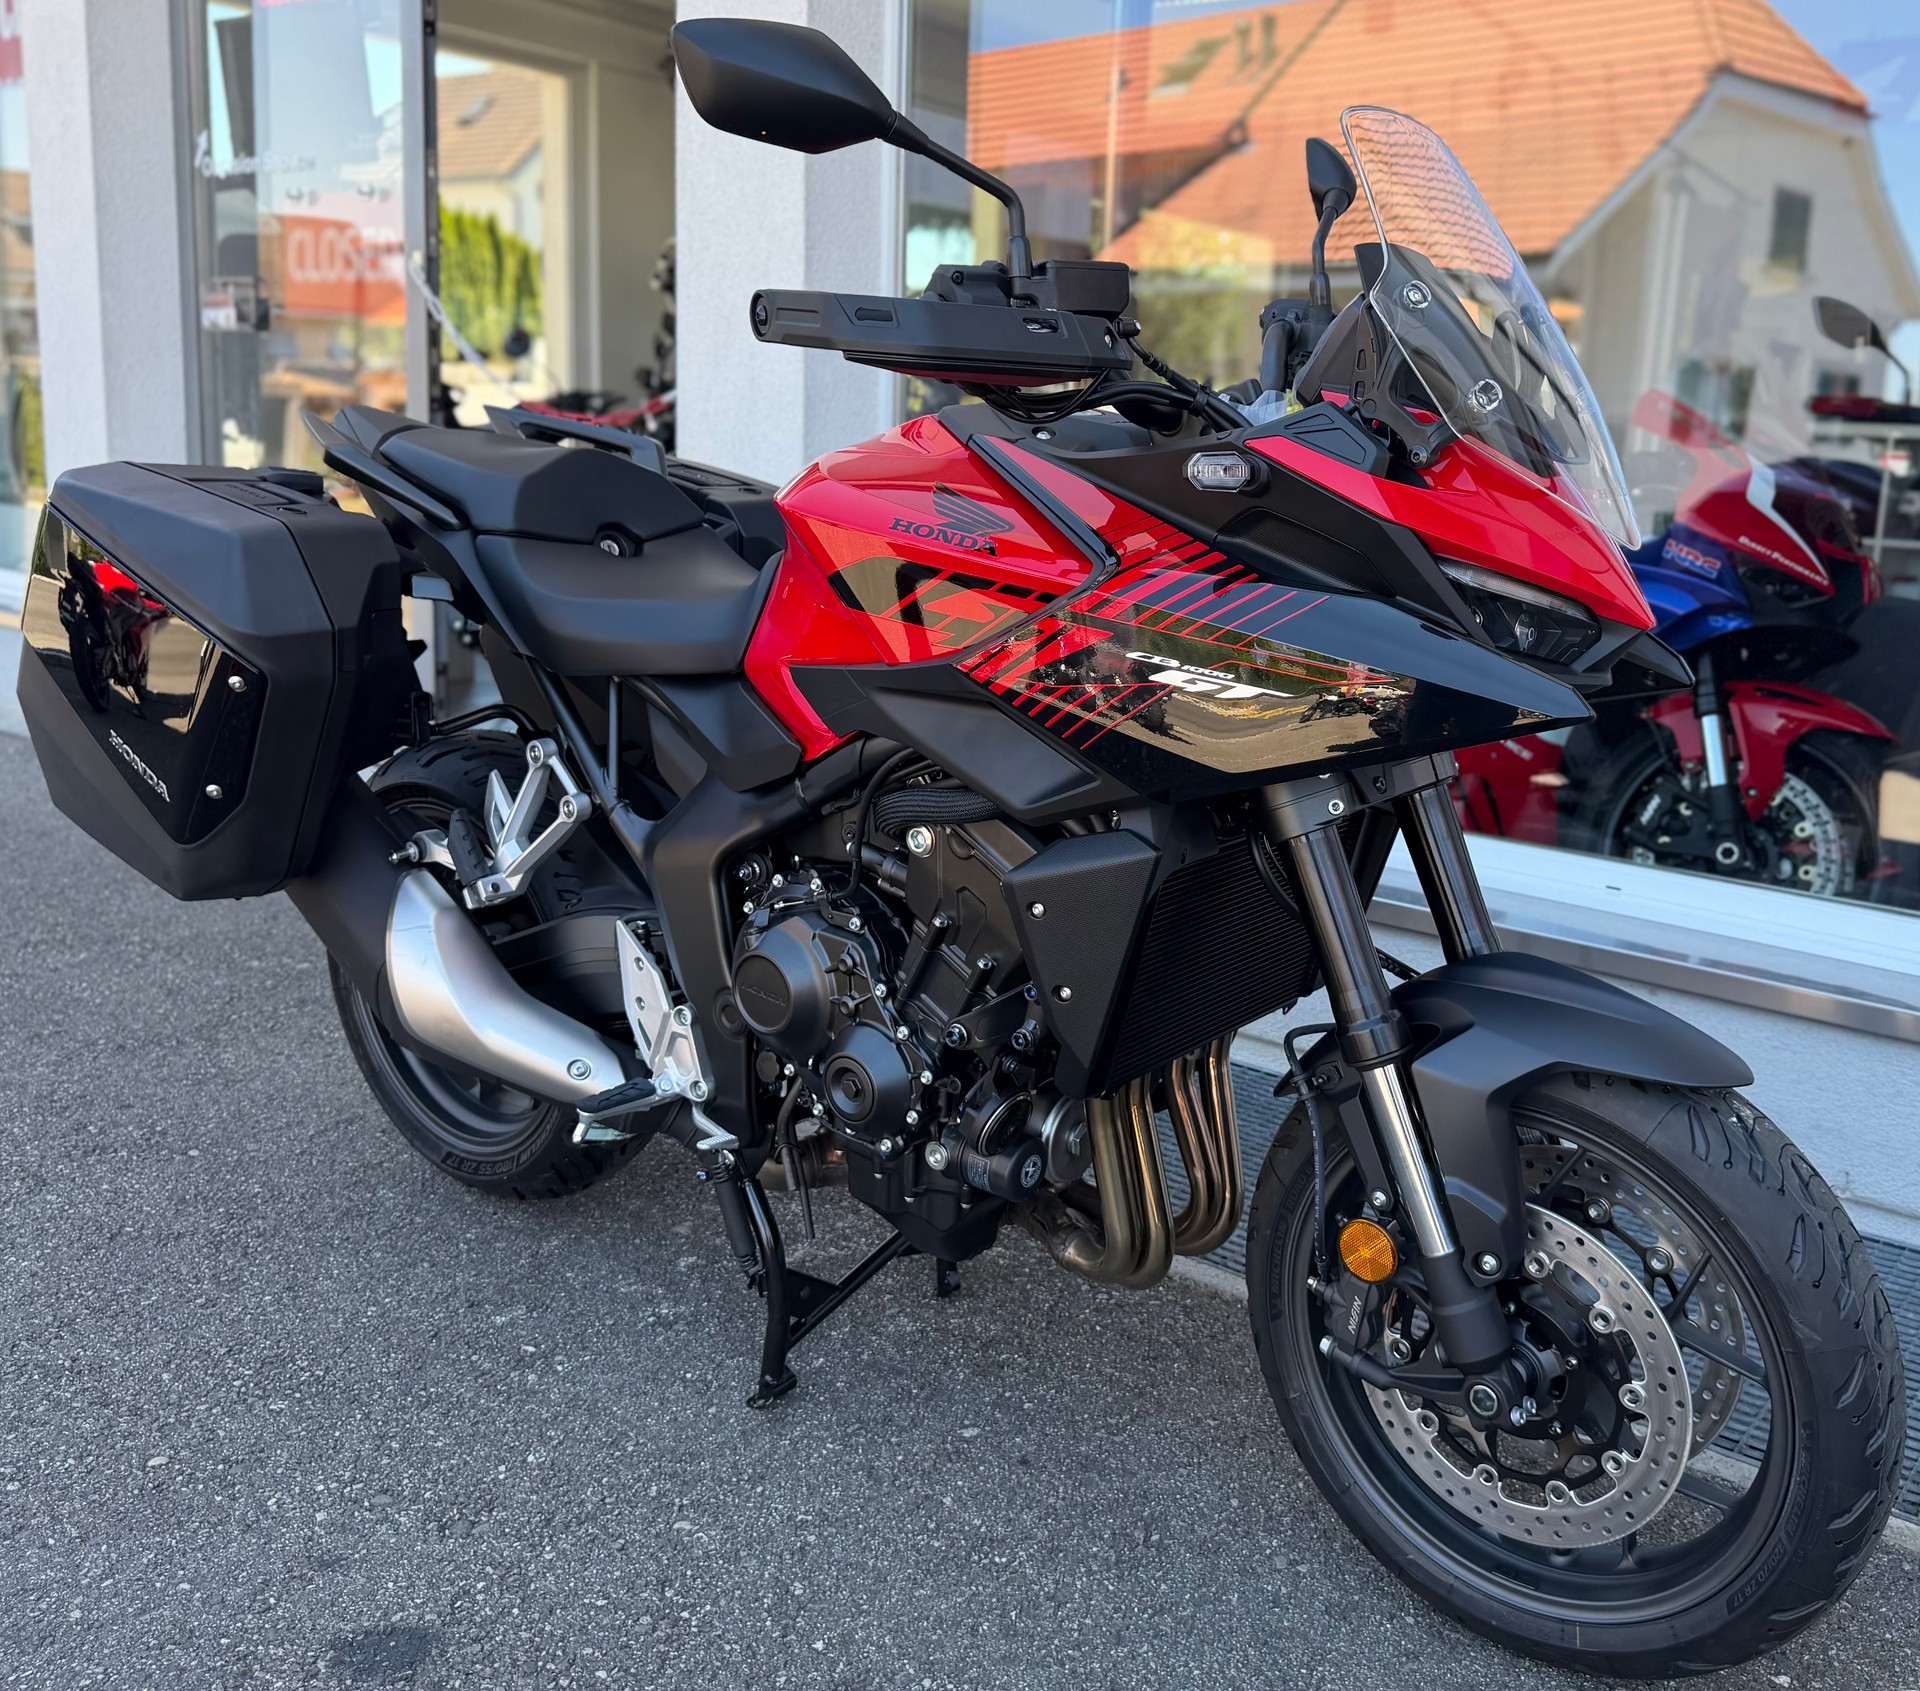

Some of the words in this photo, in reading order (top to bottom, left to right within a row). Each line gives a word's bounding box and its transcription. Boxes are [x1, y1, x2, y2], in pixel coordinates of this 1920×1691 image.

[889, 517, 998, 557] HONDA
[1661, 539, 1721, 579] HRC
[1148, 669, 1295, 699] GT
[109, 729, 170, 802] HONDA
[446, 1155, 460, 1168] 17
[462, 1160, 478, 1173] ZR
[478, 1158, 514, 1175] 180/55
[1271, 1220, 1288, 1294] MICHELIN
[1285, 1174, 1307, 1210] ROAD
[1757, 1543, 1785, 1584] 120/70
[1732, 1594, 1744, 1609] 17
[1744, 1579, 1758, 1598] ZR
